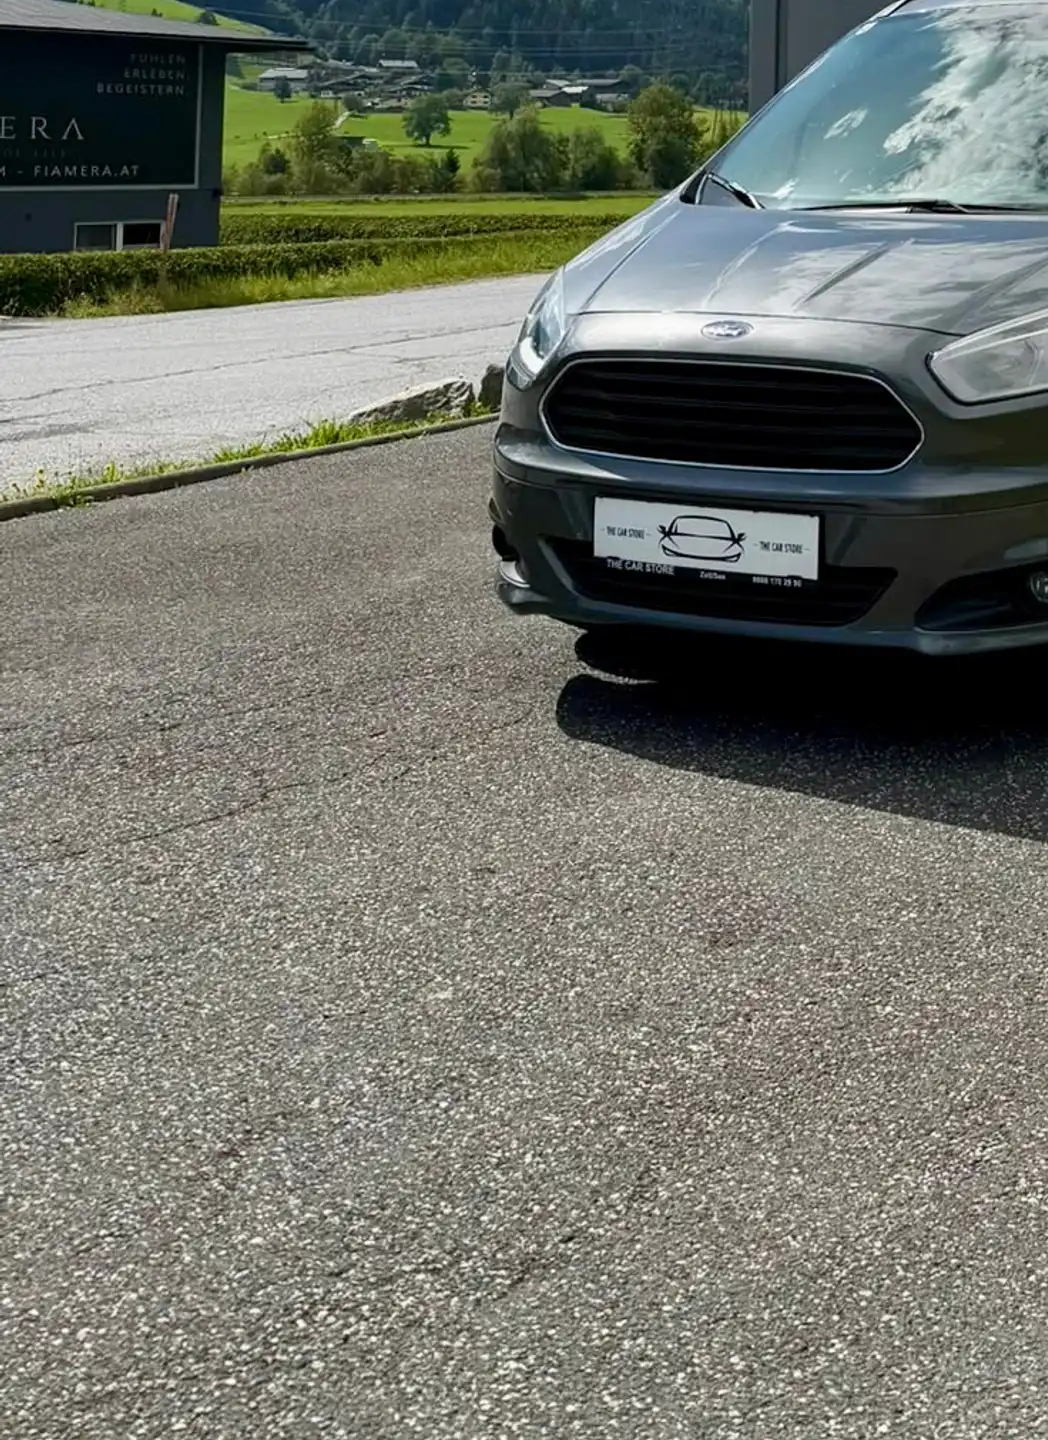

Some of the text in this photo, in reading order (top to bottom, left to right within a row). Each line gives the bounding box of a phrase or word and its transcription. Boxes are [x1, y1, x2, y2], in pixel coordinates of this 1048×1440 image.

[34, 165, 140, 178] FIAMERA.AT
[606, 559, 676, 576] THE CAR STORE
